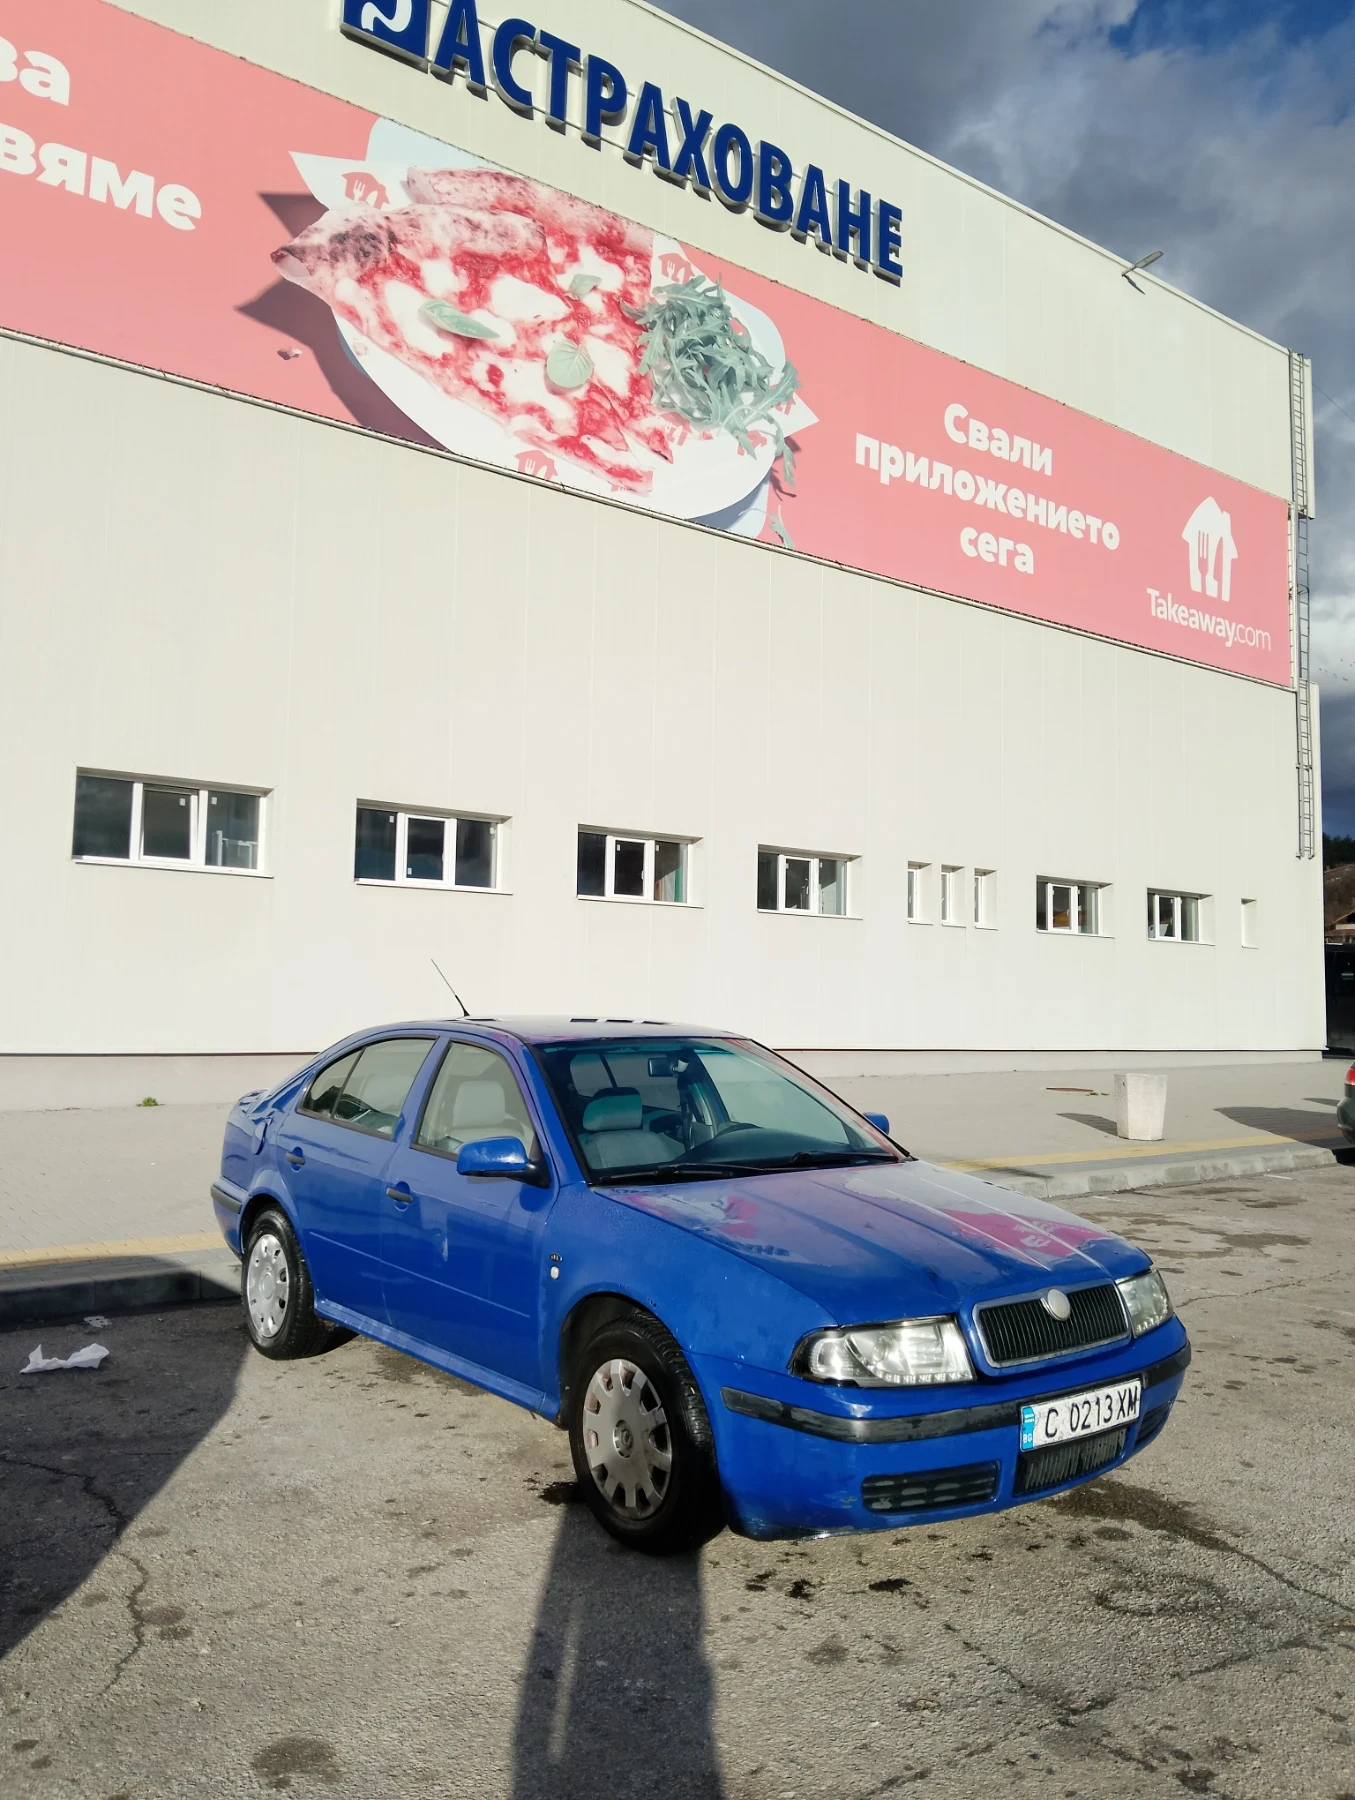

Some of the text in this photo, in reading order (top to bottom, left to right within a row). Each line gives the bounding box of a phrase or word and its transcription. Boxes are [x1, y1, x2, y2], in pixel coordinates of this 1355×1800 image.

[943, 402, 1053, 477] Свали
[854, 432, 1121, 551] приложението
[959, 526, 1035, 575] сега
[1145, 587, 1272, 652] Takeaway.com
